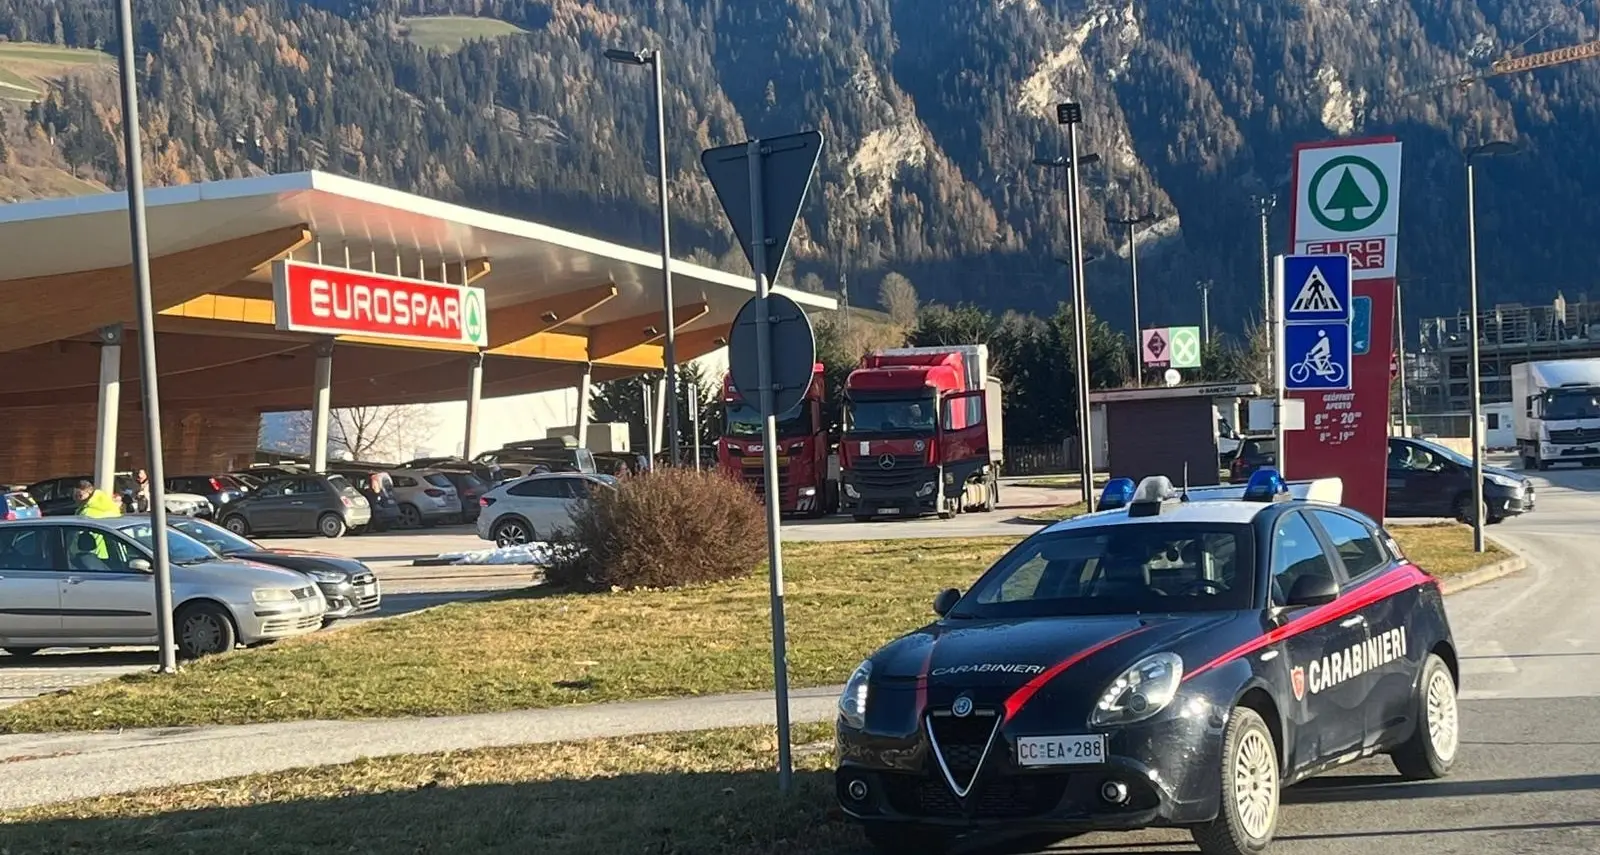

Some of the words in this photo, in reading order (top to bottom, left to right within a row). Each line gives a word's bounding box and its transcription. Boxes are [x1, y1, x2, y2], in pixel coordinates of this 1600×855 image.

[1308, 242, 1382, 255] EURO
[1352, 255, 1383, 267] AR
[310, 279, 461, 330] EUROSPAR
[1308, 626, 1407, 694] CARABINIERI
[931, 663, 1046, 676] CARABINIERI
